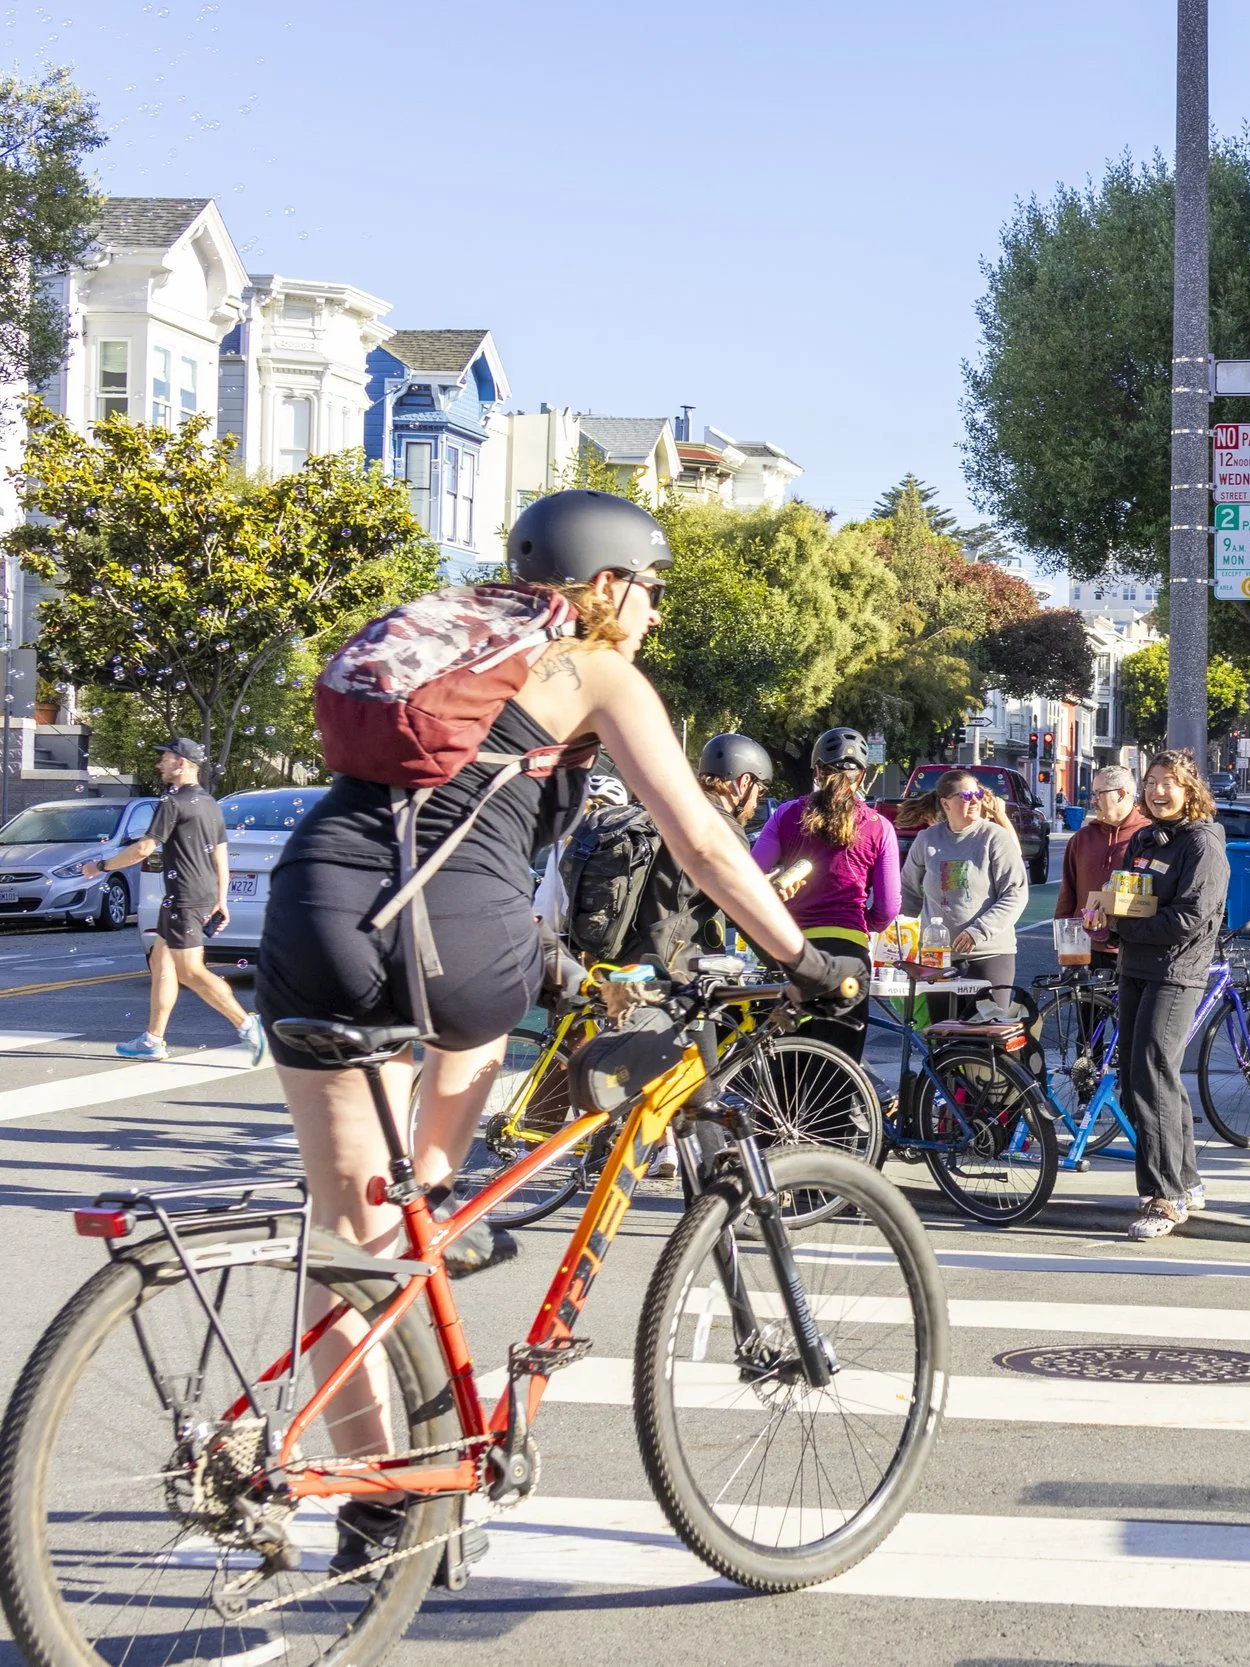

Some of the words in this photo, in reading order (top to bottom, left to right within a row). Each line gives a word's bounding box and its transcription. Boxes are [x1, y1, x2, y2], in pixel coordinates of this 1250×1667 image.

[1217, 428, 1236, 447] NO
[1221, 492, 1248, 500] STREET
[1221, 509, 1234, 528] 2
[1223, 556, 1244, 565] MON
